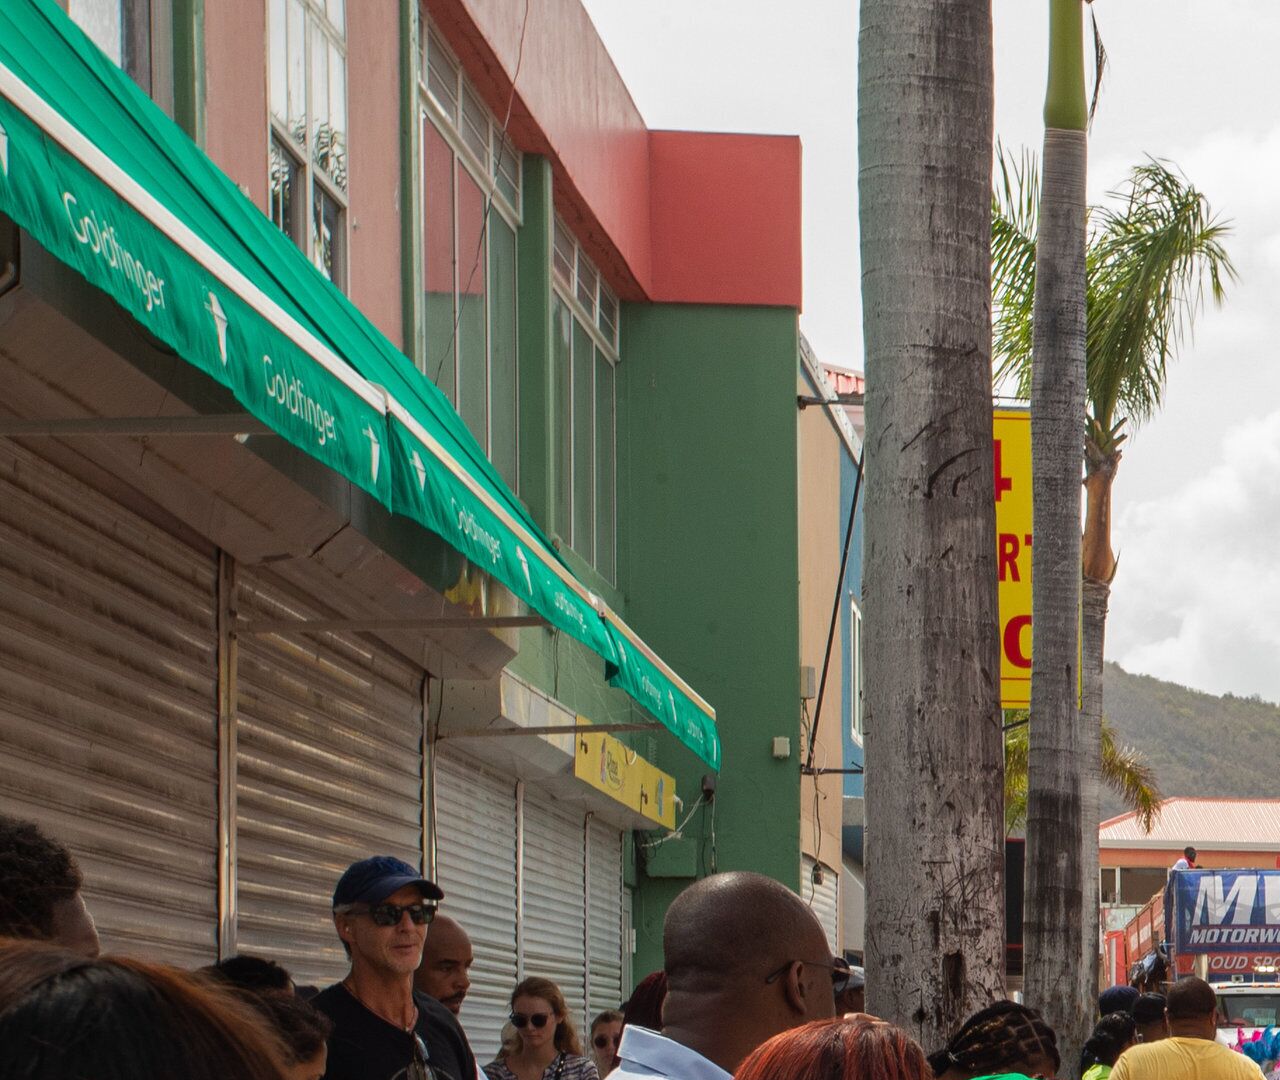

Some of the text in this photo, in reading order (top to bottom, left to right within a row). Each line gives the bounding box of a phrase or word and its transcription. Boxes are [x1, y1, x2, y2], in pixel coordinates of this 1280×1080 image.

[62, 191, 165, 312] Goldfinger
[263, 354, 337, 445] Goldfinger
[1191, 956, 1249, 970] OUD
